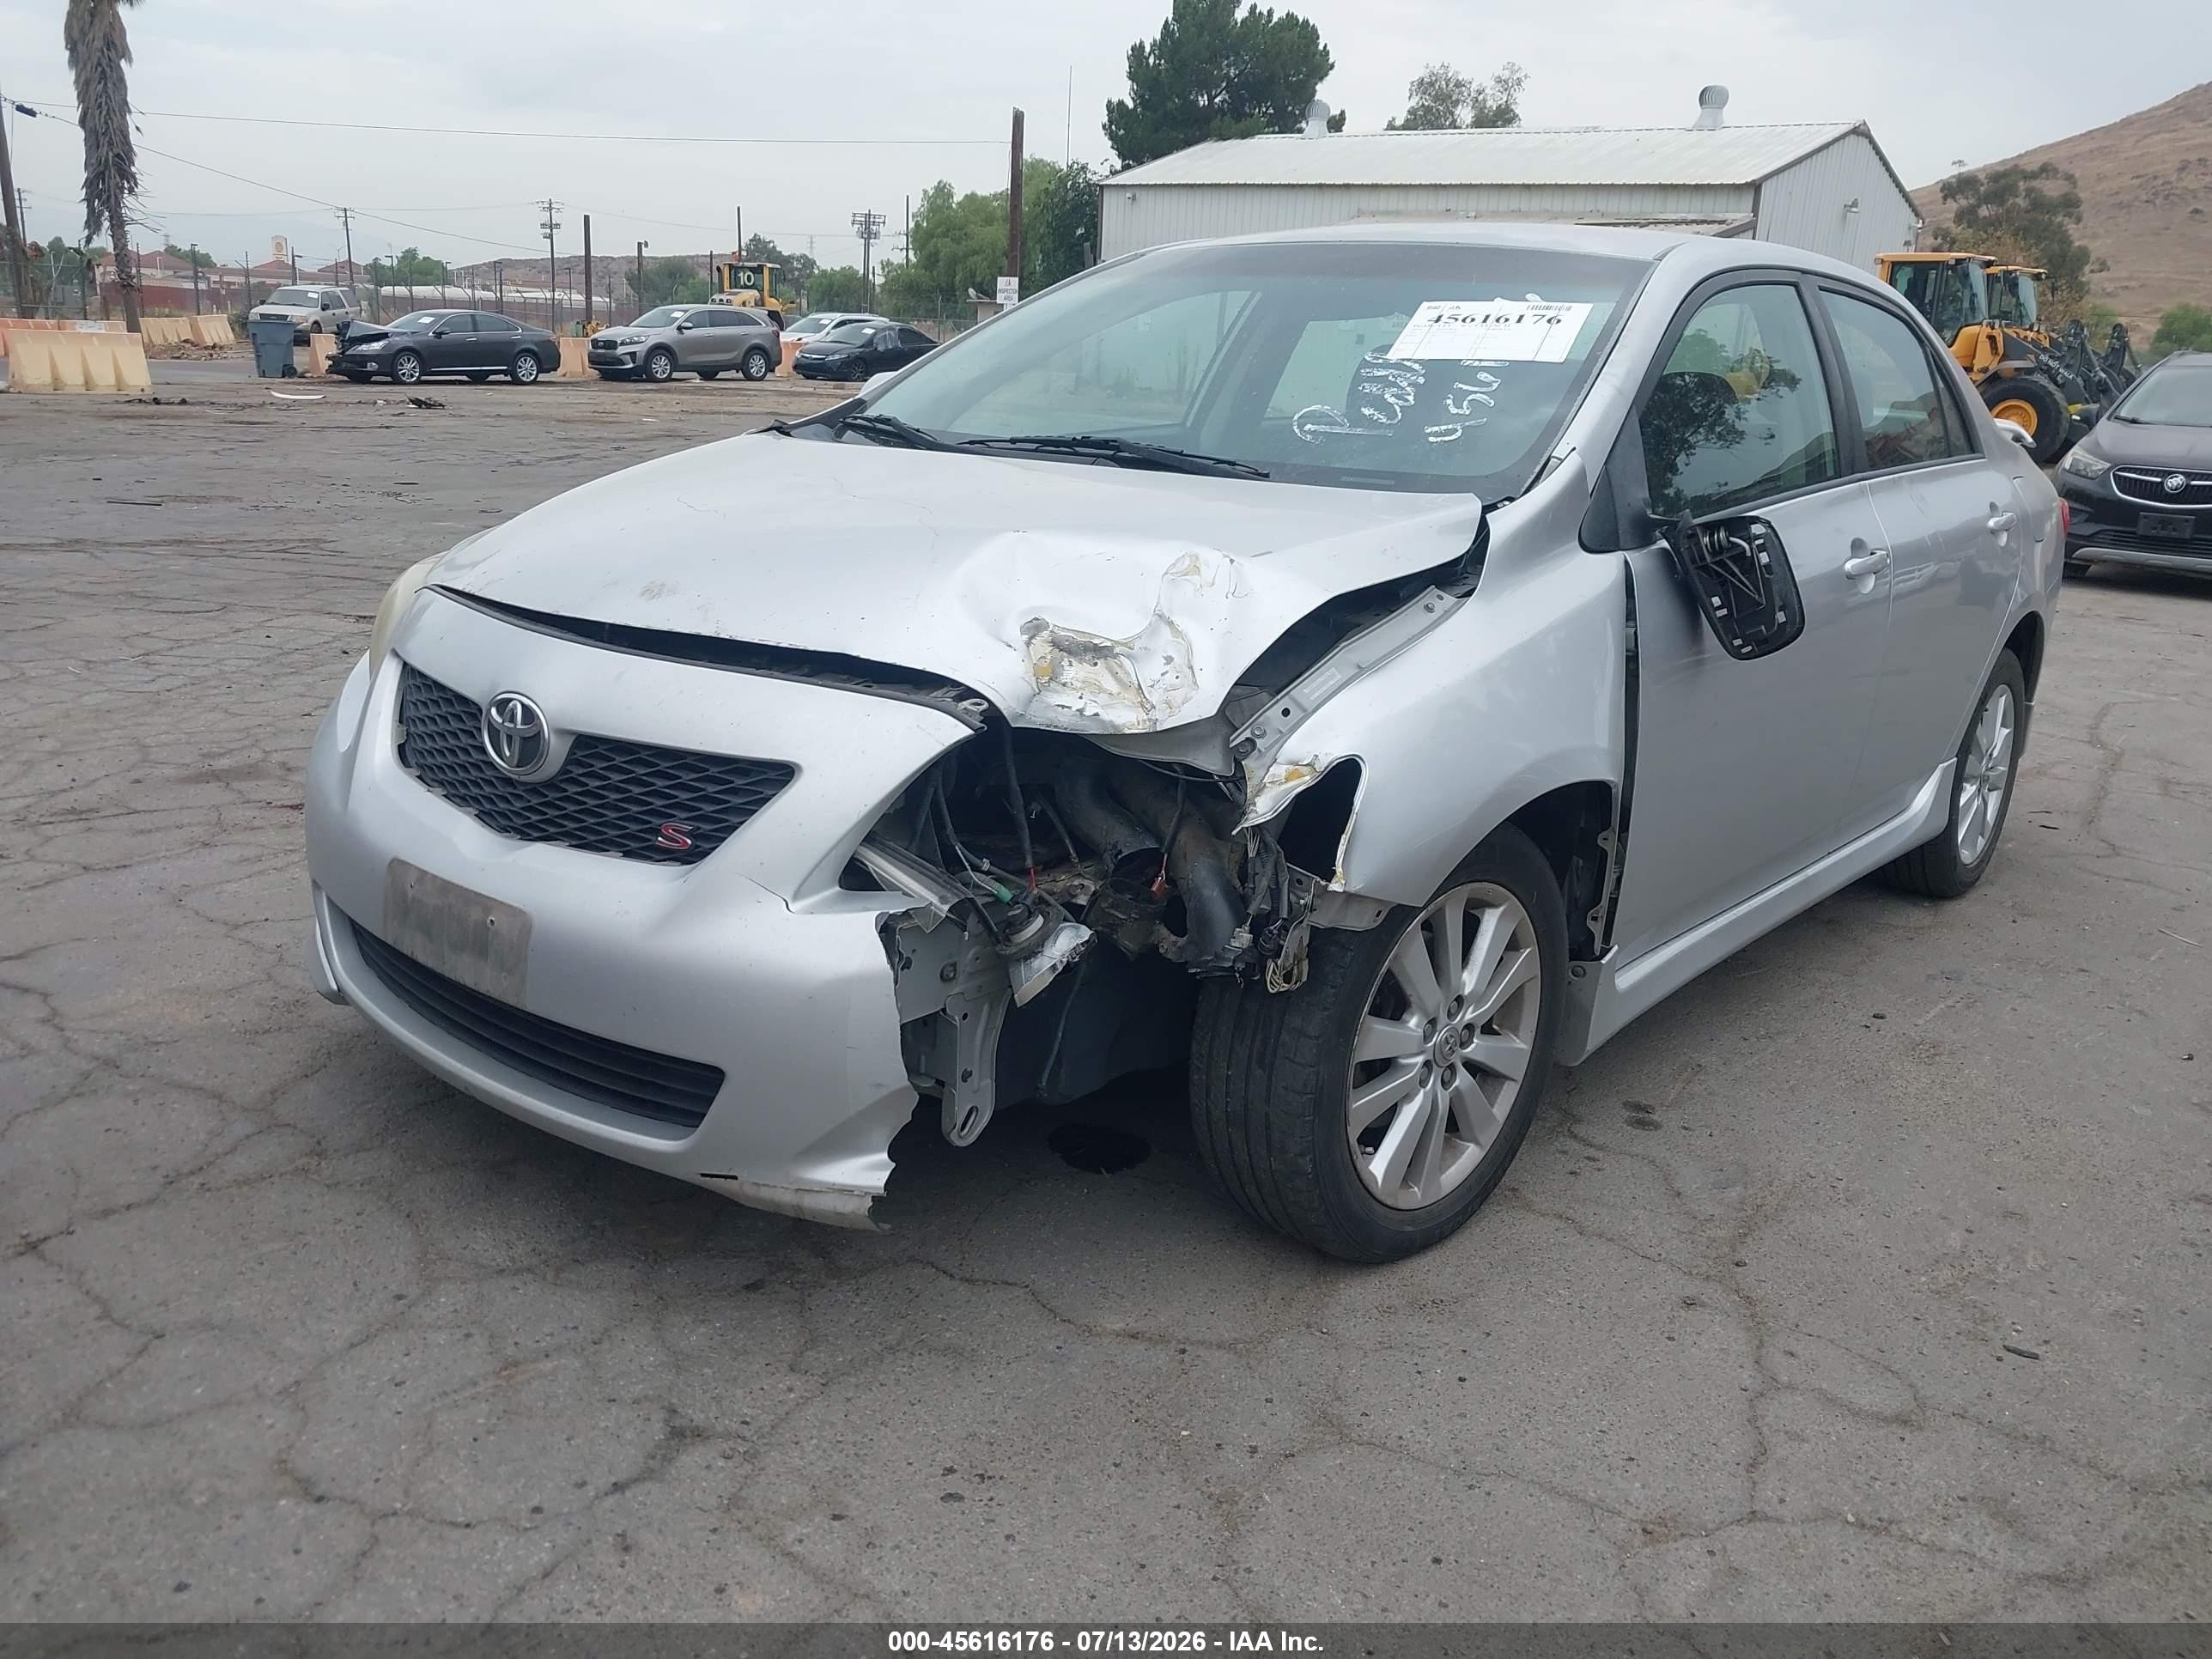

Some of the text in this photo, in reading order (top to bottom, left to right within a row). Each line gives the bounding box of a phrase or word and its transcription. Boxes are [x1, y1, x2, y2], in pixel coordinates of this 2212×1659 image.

[738, 271, 755, 286] 10
[1426, 313, 1564, 325] 45616176
[655, 823, 695, 850] S
